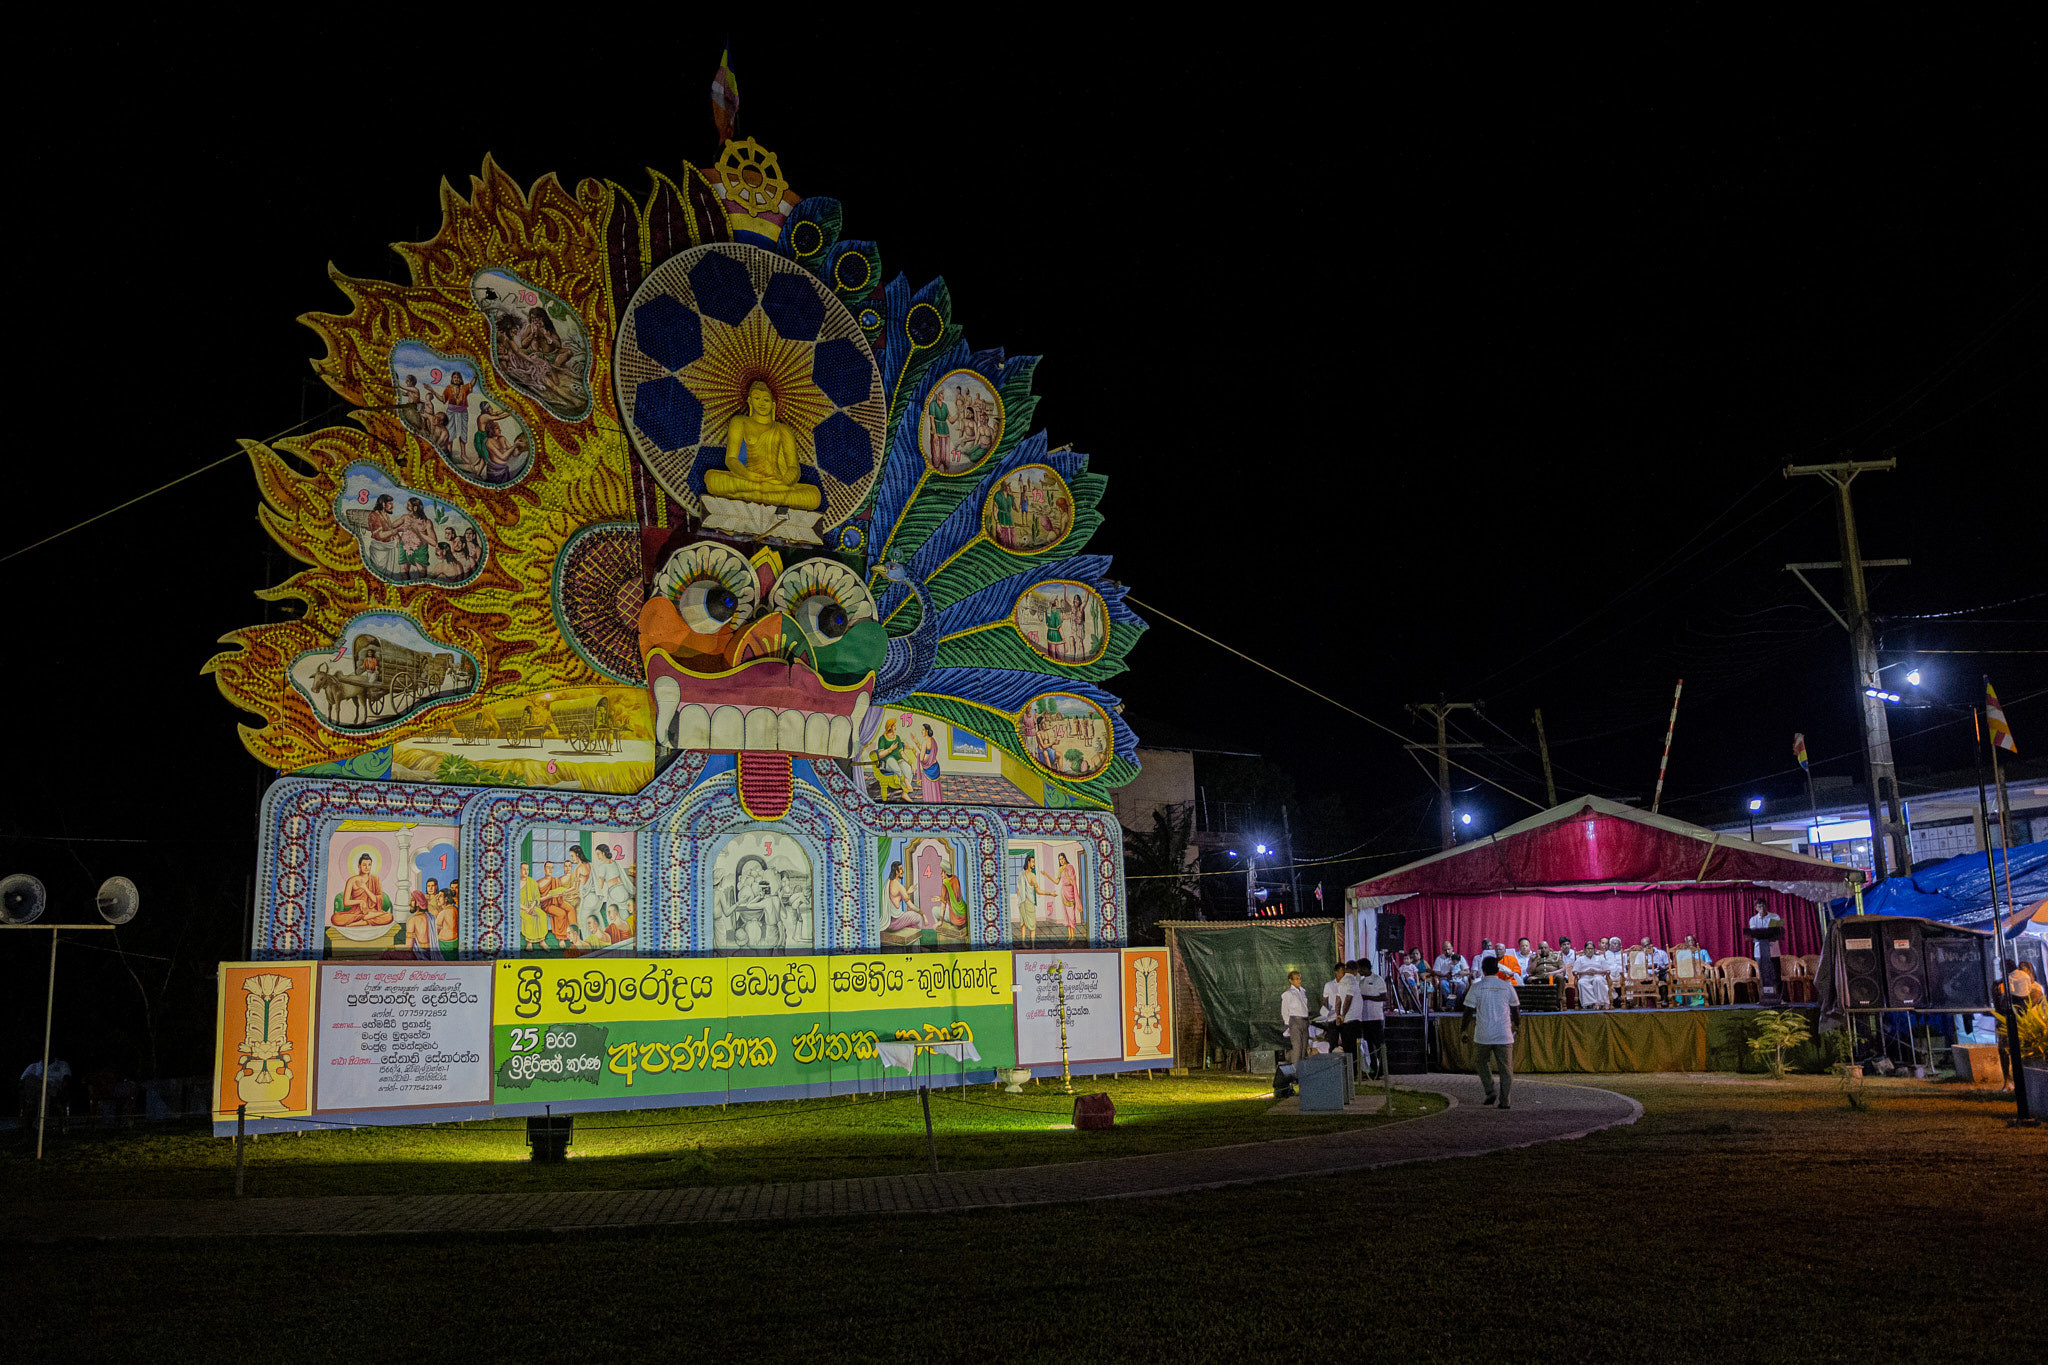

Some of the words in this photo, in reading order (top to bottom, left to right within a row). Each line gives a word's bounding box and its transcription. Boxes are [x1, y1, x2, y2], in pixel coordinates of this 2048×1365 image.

[518, 289, 538, 306] 10
[430, 368, 442, 384] 9
[950, 450, 962, 463] 11
[358, 489, 370, 505] 8
[1032, 488, 1044, 503] 12
[1027, 631, 1039, 645] 13
[331, 646, 347, 663] 7
[900, 713, 914, 728] 15
[1053, 725, 1065, 738] 14
[547, 758, 558, 774] 6
[613, 844, 625, 862] 2
[764, 841, 773, 858] 3
[438, 853, 448, 871] 1
[923, 864, 932, 879] 4
[1046, 902, 1054, 917] 5
[556, 963, 713, 1015] කුමාරෝදය
[730, 961, 817, 1008] බෞද්ධ
[917, 959, 1001, 999] කුමාරකන්ද
[346, 991, 416, 1007] පුෂ්පානන්ද
[398, 1009, 447, 1018] 0775972852
[361, 1031, 388, 1042] මංජුල
[509, 1027, 540, 1053] 25
[545, 1032, 577, 1049] වරට
[791, 1022, 881, 1065] ජාතක
[361, 1043, 387, 1053] මංජුල
[380, 1051, 420, 1065] සේනානි
[425, 1050, 480, 1064] සේනාරත්න
[508, 1054, 563, 1080] ඉදිරිපත්
[399, 1084, 442, 1092] 0777542349
